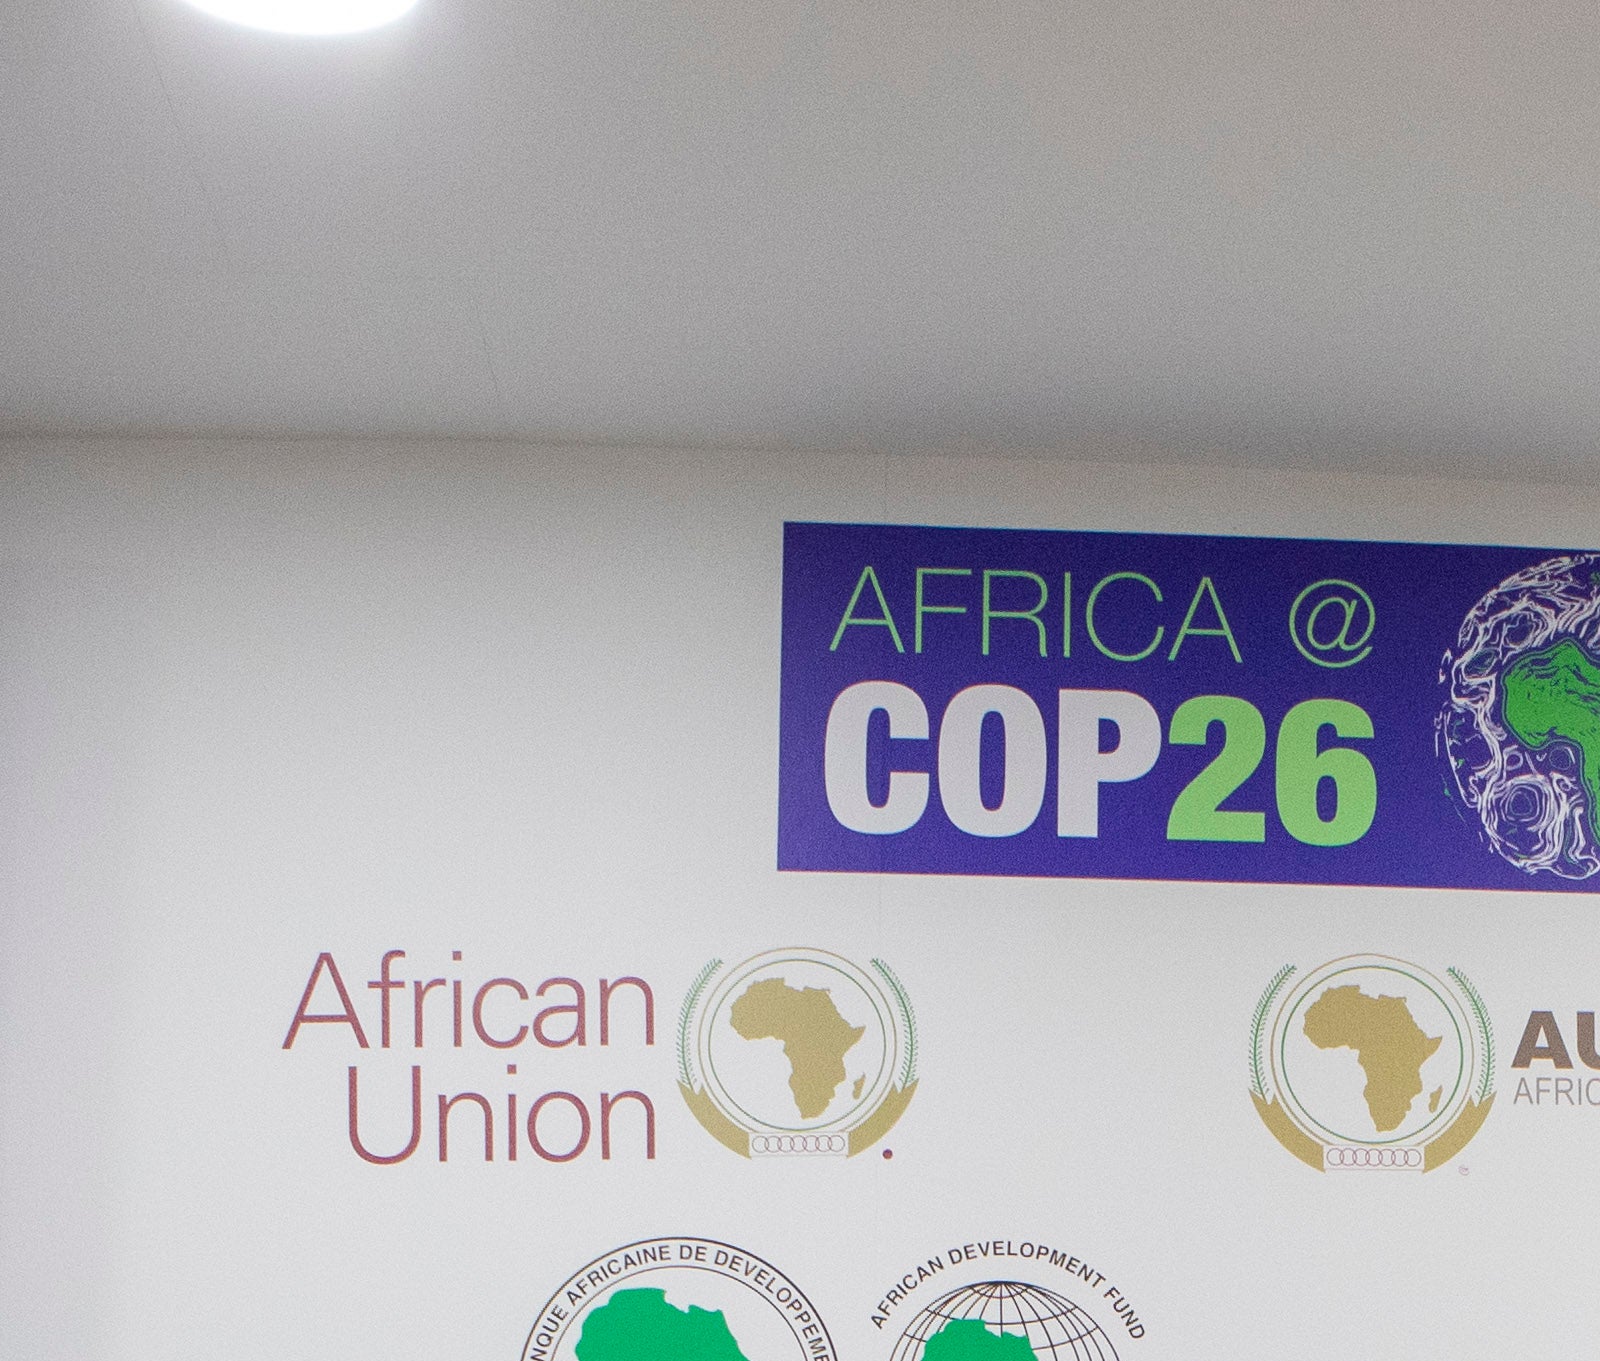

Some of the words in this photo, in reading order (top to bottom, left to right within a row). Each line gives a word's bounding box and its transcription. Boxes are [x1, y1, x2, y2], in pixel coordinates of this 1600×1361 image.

[830, 566, 1242, 663] AFRICA
[1289, 579, 1376, 668] @
[824, 680, 1378, 846] COP26
[281, 949, 655, 1050] African
[347, 1064, 656, 1165] Union
[566, 1244, 672, 1306] AFRICAINE
[679, 1244, 707, 1262] DE
[870, 1255, 946, 1330] AFRICAN
[947, 1240, 1106, 1289] DEVELOPMENT
[1102, 1285, 1146, 1341] FUND
